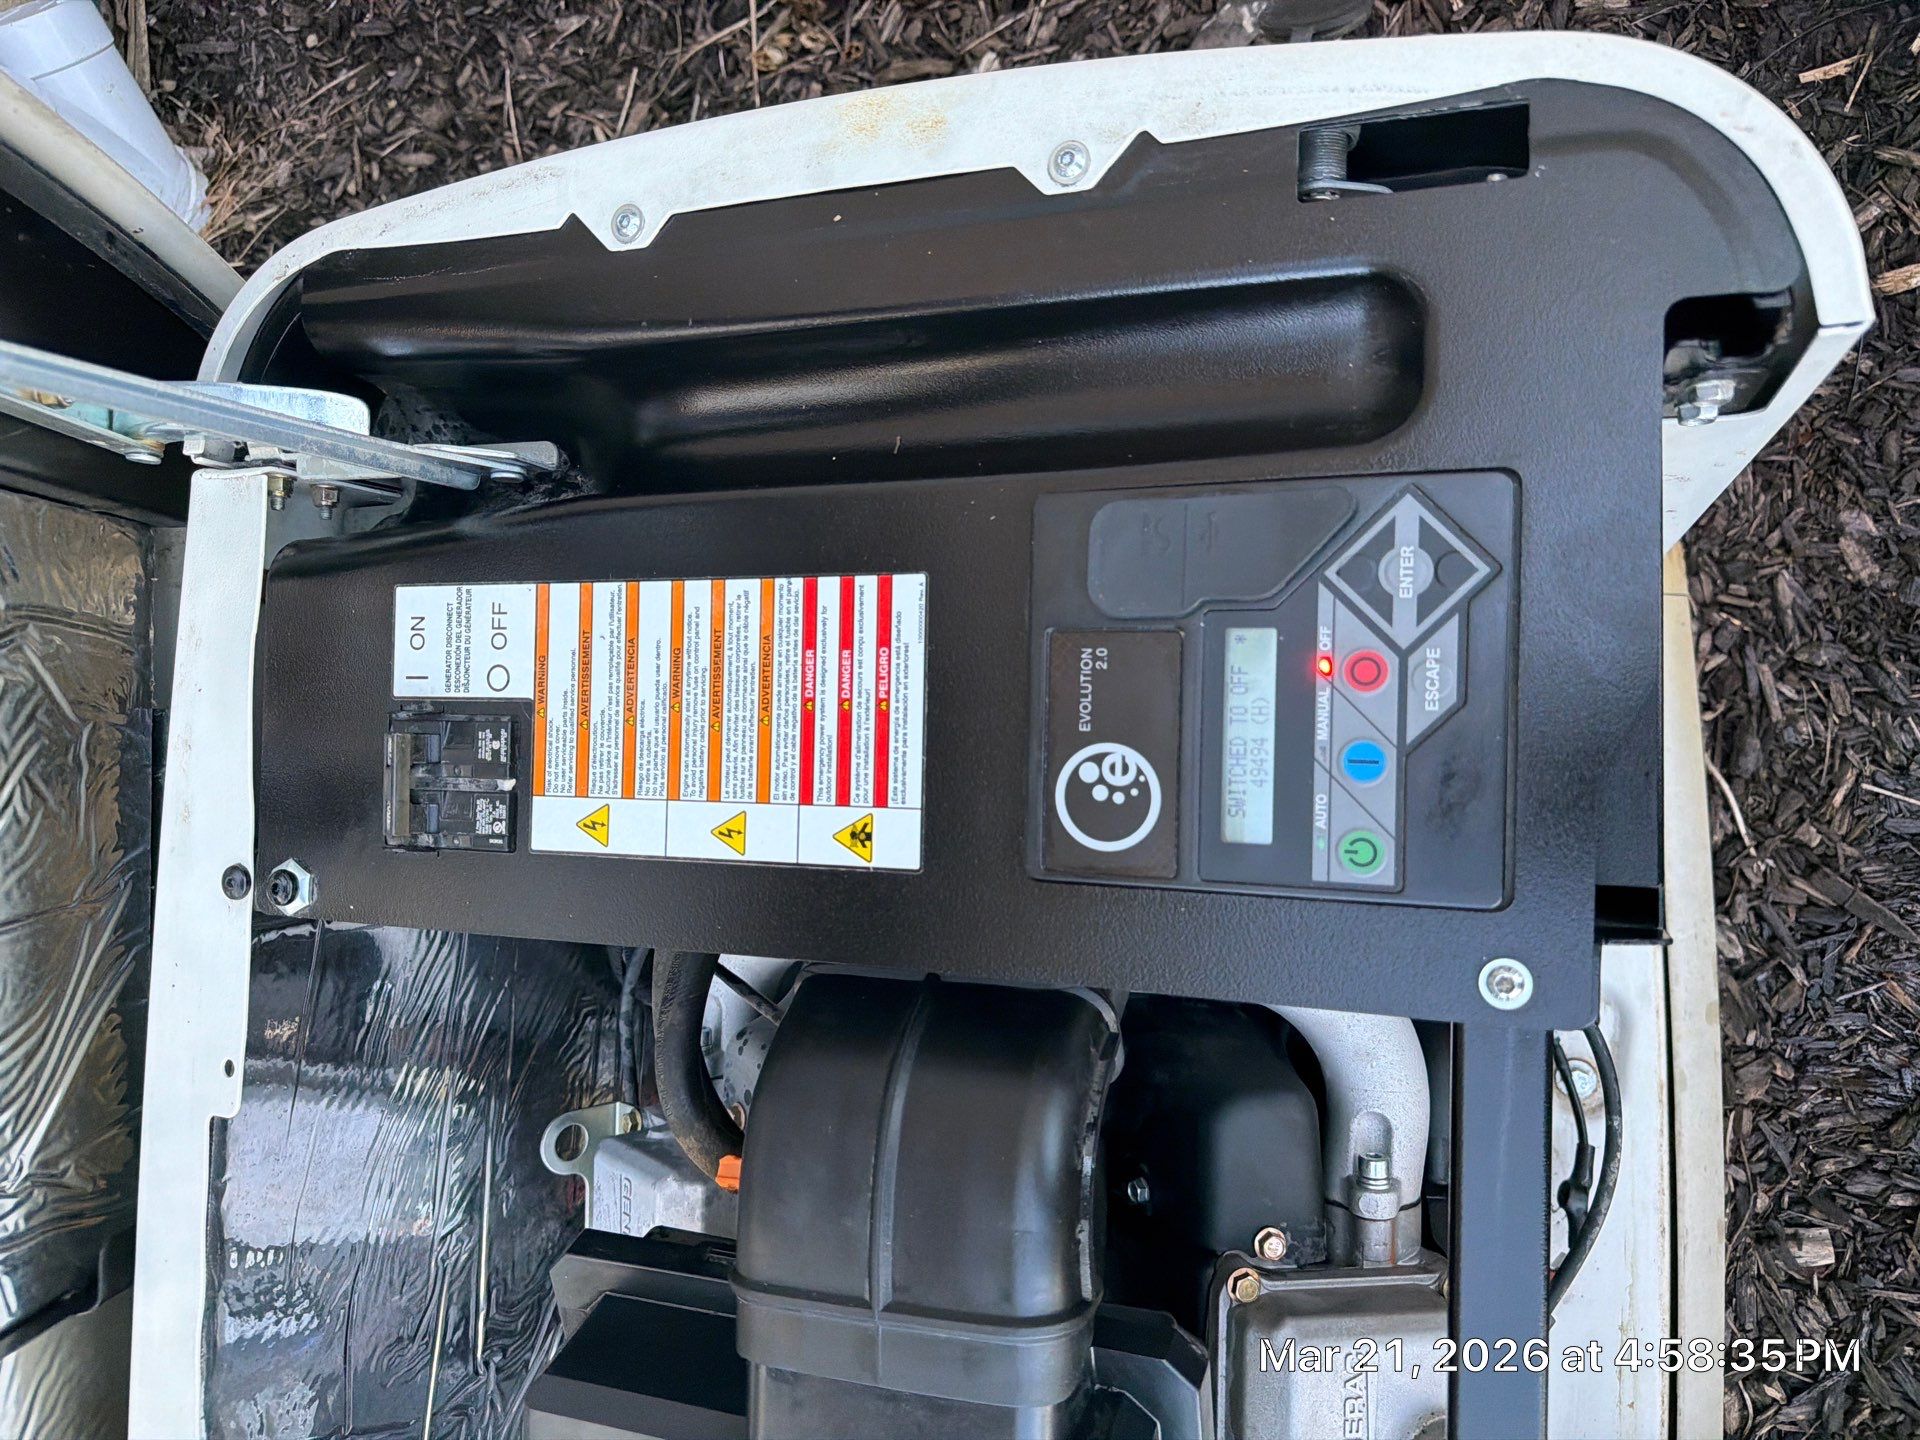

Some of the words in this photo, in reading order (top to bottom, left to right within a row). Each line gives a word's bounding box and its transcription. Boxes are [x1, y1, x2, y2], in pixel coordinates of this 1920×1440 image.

[1399, 546, 1414, 599] ENTER
[410, 617, 425, 650] ON
[445, 602, 453, 648] DISCONNECT
[464, 588, 472, 633] GÉNÉRATEUR
[491, 602, 507, 650] OFF
[464, 635, 471, 645] DU
[820, 616, 828, 655] exclusively
[1096, 648, 1108, 669] 2.0
[1319, 626, 1331, 651] OFF
[444, 649, 452, 693] GENERATOR
[453, 645, 461, 693] DESCONEXIÓN
[463, 646, 471, 693] DISJONCTEUR
[538, 655, 546, 704] WARNING
[581, 630, 590, 716] AVERTISSEMENT
[627, 637, 635, 713] ADVERTENCIA
[672, 647, 681, 698] WARNING
[712, 628, 722, 718] AVERTISSEMENT
[762, 634, 771, 712] ADVERTENCIA
[805, 650, 814, 697] DANGER
[842, 649, 851, 698] DANGER
[879, 647, 888, 698] PELIGRO
[894, 662, 902, 704] emergencia
[1078, 648, 1093, 731] EVOLUTION
[1229, 666, 1248, 696] OFF
[1425, 648, 1441, 711] ESCAPE
[775, 689, 783, 712] puede
[819, 697, 827, 722] system
[1229, 705, 1247, 724] TO
[1251, 697, 1270, 725] (H)
[1316, 688, 1329, 740] MANUAL
[691, 718, 699, 738] injury
[698, 744, 706, 768] battery
[1227, 736, 1247, 818] SWITCHED
[1250, 737, 1269, 788] 49494
[1315, 793, 1327, 829] AUTO
